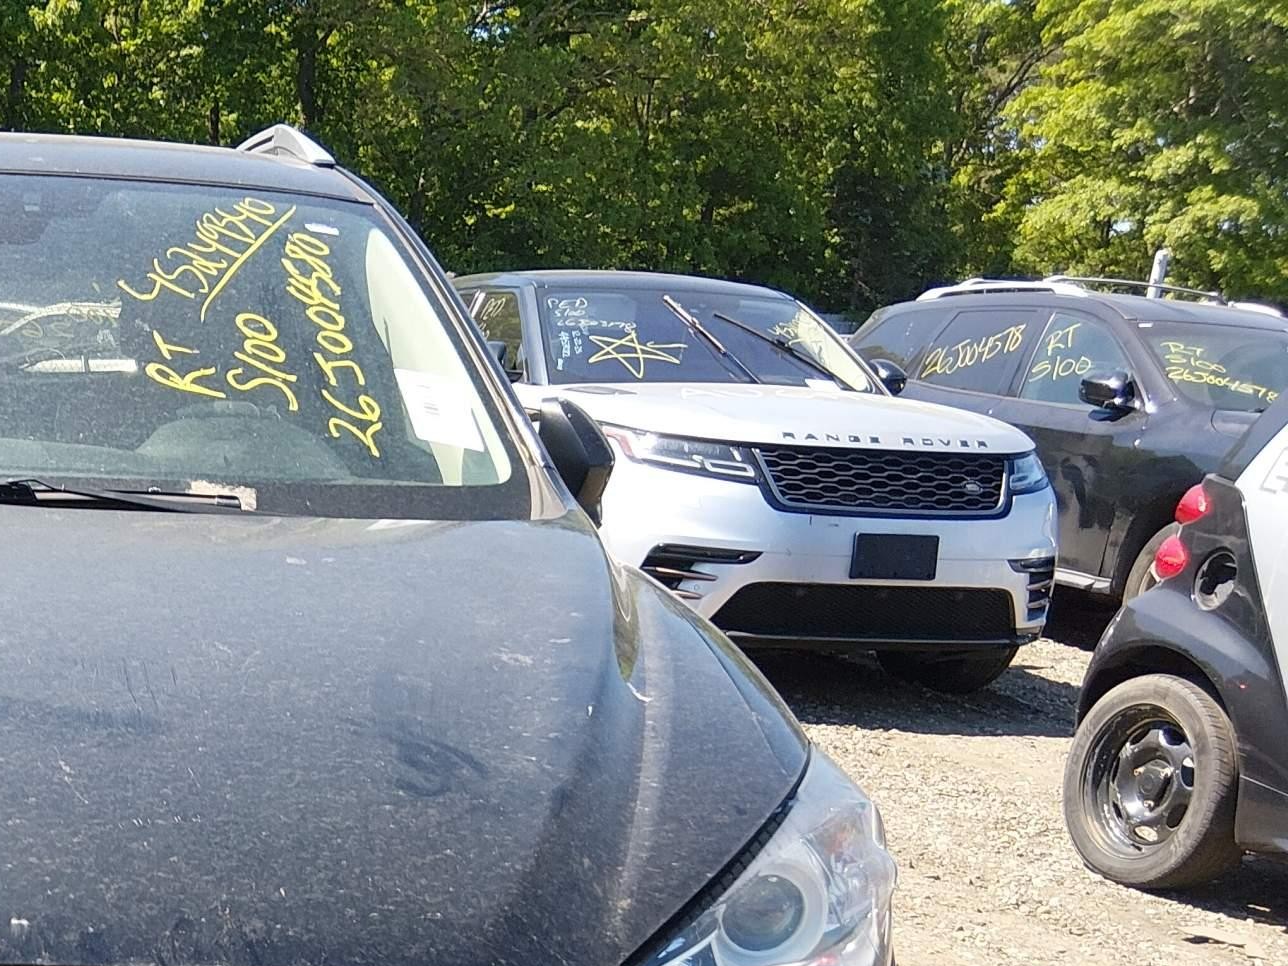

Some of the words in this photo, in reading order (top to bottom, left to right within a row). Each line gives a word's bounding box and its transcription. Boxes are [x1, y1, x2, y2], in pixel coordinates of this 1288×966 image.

[921, 323, 1027, 378] 26J004578
[1046, 323, 1081, 356] RT
[1160, 342, 1206, 357] RT
[144, 330, 226, 399] RT
[225, 312, 299, 411] S100
[1028, 356, 1092, 383] S100
[1165, 354, 1227, 373] S100
[1165, 366, 1280, 404] 26J004578
[782, 432, 881, 444] RANGE
[903, 437, 989, 448] ROVER
